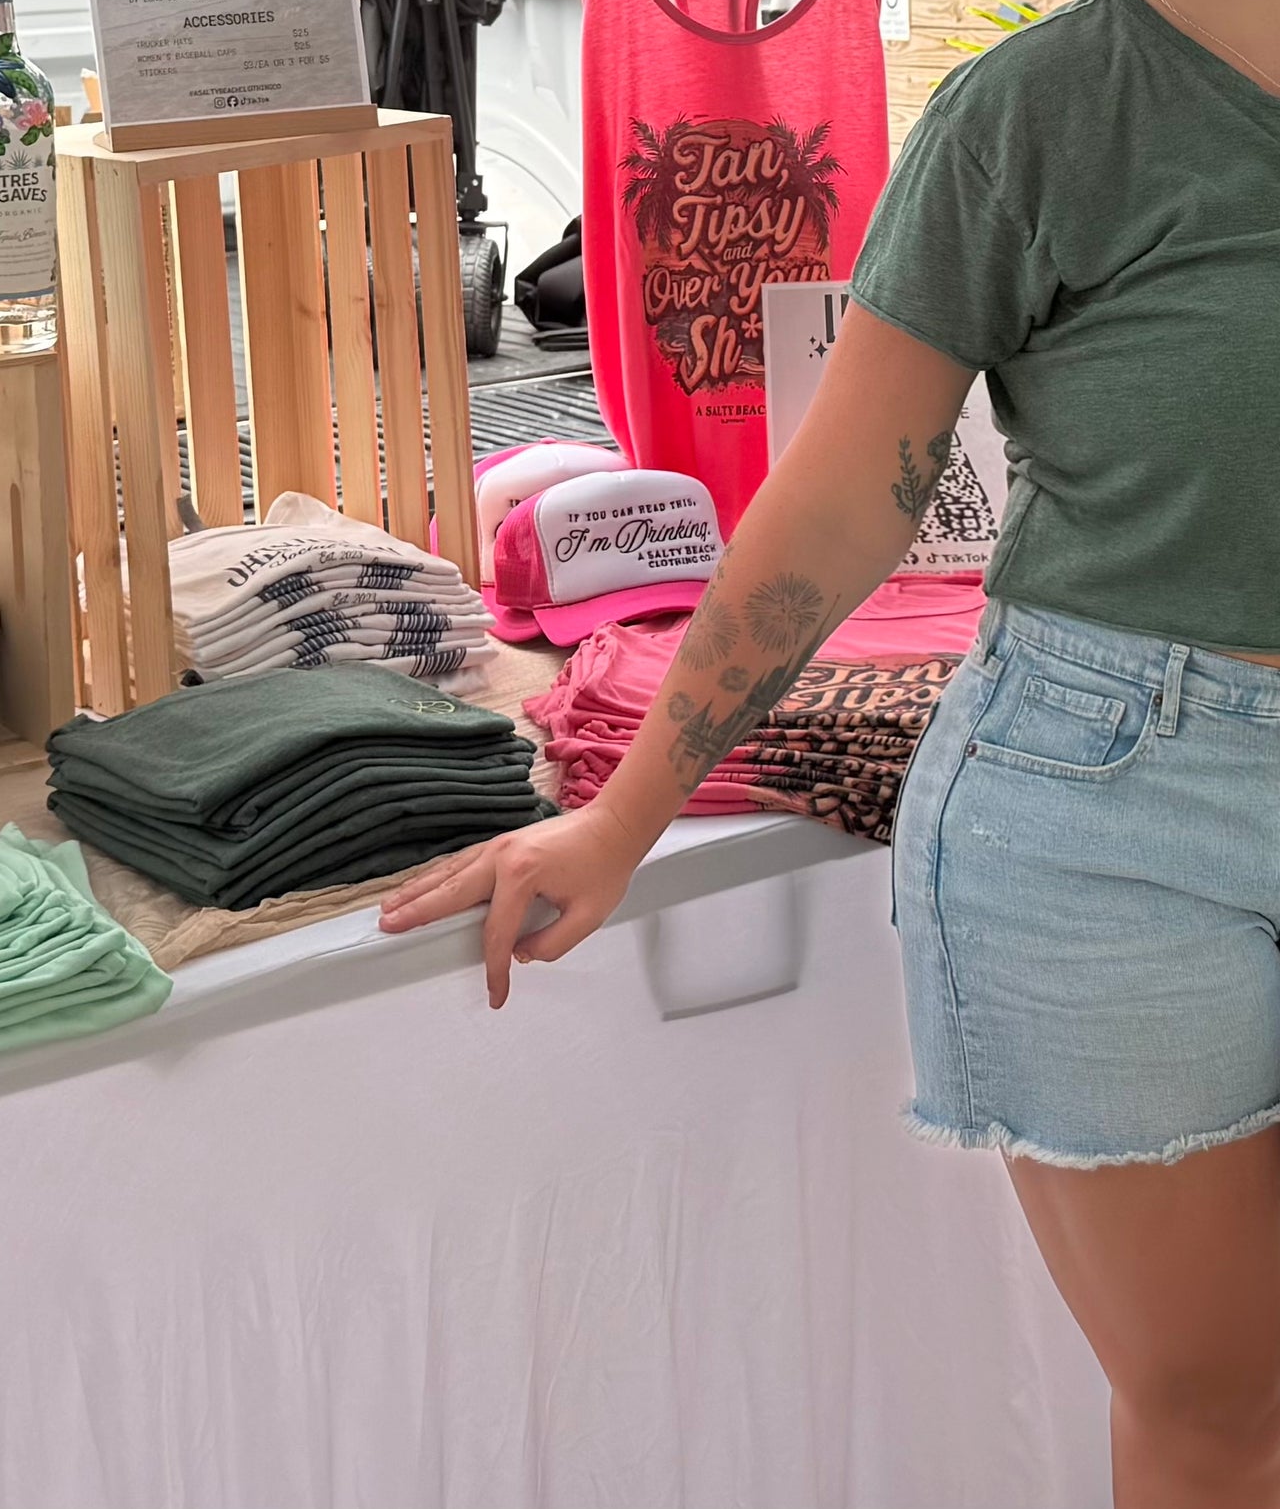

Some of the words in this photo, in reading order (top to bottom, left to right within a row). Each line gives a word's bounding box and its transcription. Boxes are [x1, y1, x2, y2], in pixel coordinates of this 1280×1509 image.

[182, 10, 275, 29] ACCESSORIES
[136, 39, 170, 49] TRUCKER
[173, 37, 194, 46] HATS
[292, 28, 309, 38] $25
[136, 53, 172, 63] WOMEN'S
[174, 49, 214, 60] BASEBALL
[216, 47, 238, 57] CAPS
[293, 41, 311, 51] $25
[138, 67, 178, 78] STICKERS
[273, 57, 285, 68] OR
[288, 57, 295, 67] 3
[298, 55, 315, 66] FOR
[319, 54, 330, 65] $5
[672, 130, 790, 193] Tan,
[671, 191, 806, 261] Tipsy
[722, 242, 754, 261] and
[643, 264, 721, 323] Over
[695, 407, 703, 417] A
[705, 405, 735, 417] SALTY
[568, 513, 580, 523] IF
[586, 509, 608, 522] YOU
[612, 506, 634, 519] CAN
[638, 502, 666, 515] READ
[669, 497, 697, 510] THIS,
[554, 527, 612, 563] I'm
[614, 518, 712, 554] Drinking.
[340, 550, 364, 561] 2023
[637, 551, 646, 561] A
[647, 547, 683, 560] SALTY
[685, 544, 717, 556] BEACH
[648, 555, 699, 569] CLOTHING
[700, 553, 715, 563] CO.
[942, 553, 990, 564] TikTok
[352, 592, 377, 604] 2023
[788, 683, 942, 712] Tips
